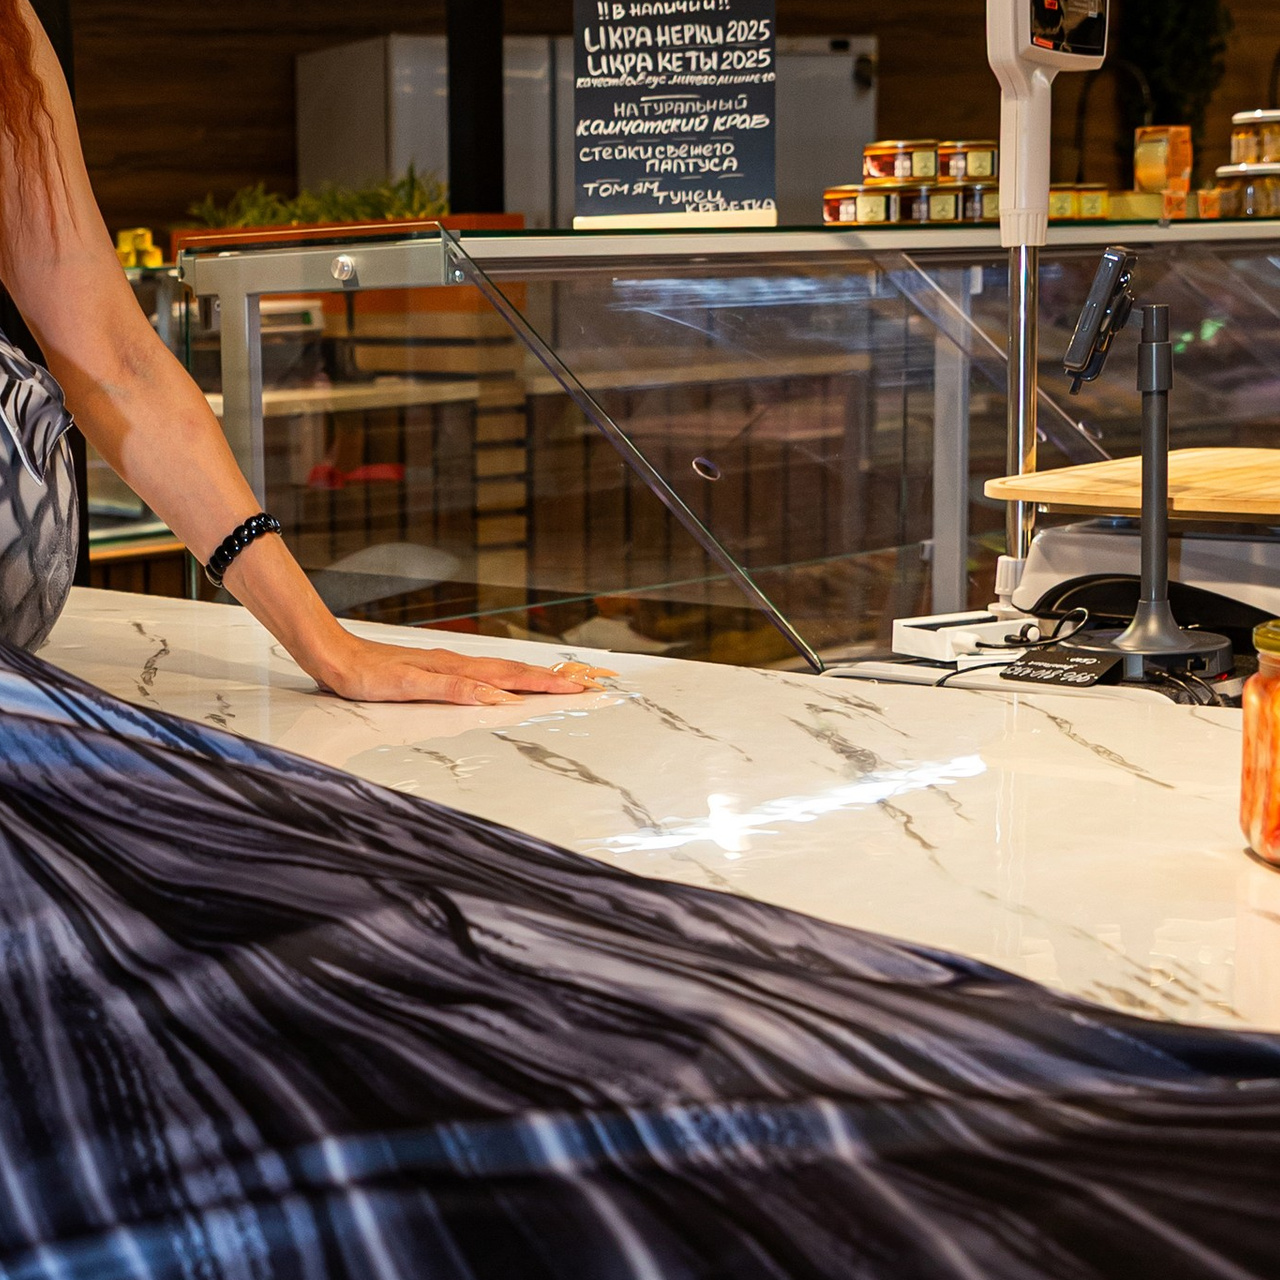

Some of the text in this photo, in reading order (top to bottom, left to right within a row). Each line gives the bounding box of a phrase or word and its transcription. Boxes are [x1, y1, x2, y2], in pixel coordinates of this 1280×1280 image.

[584, 26, 653, 53] ИКРА
[725, 19, 771, 42] 2025
[587, 52, 654, 76] ИКРА
[720, 49, 772, 70] 2025
